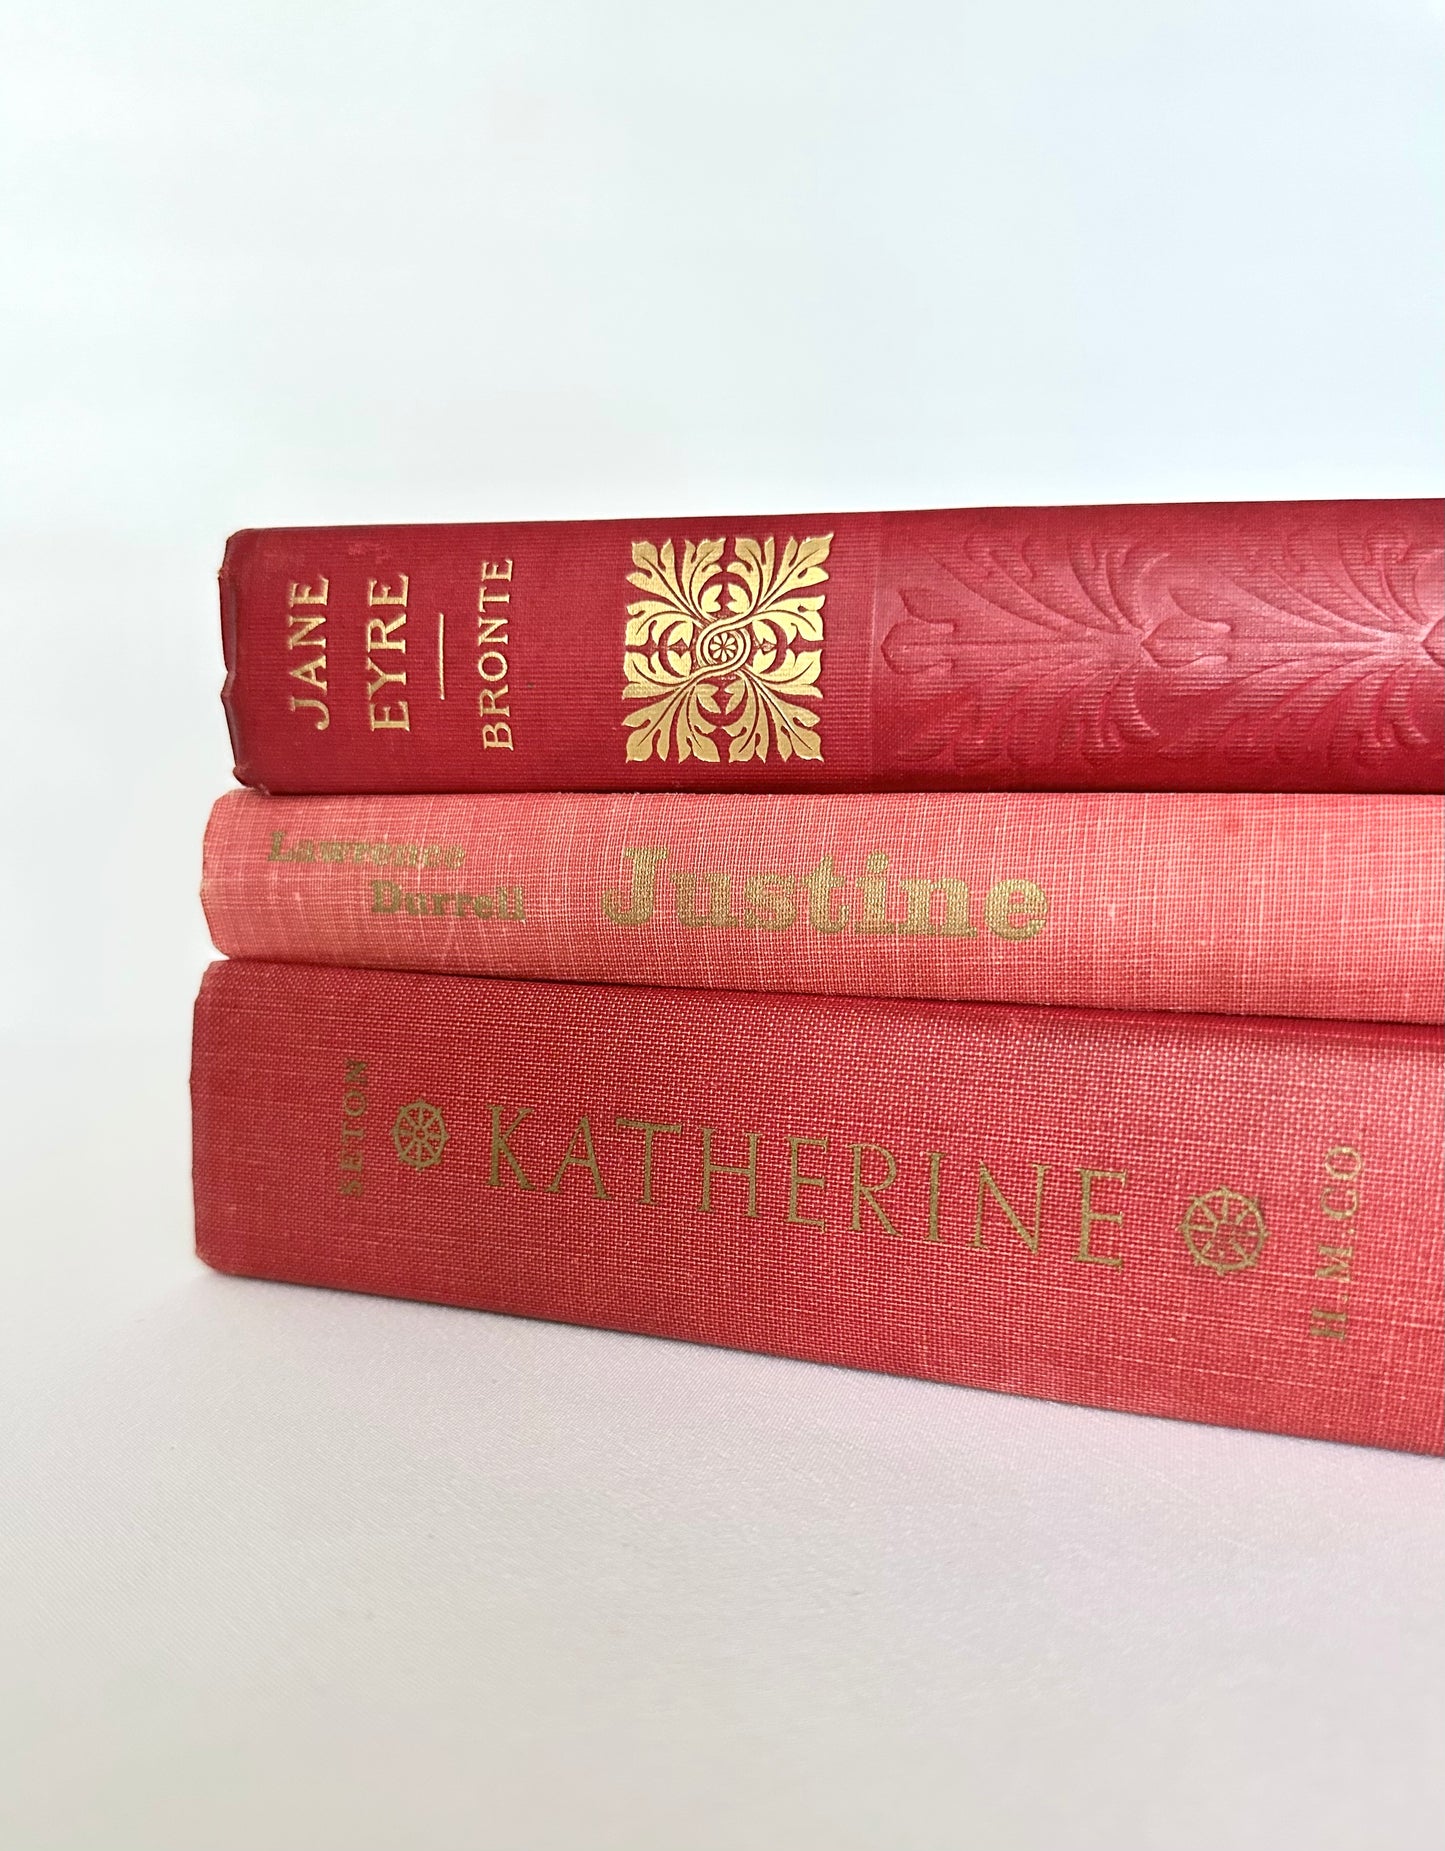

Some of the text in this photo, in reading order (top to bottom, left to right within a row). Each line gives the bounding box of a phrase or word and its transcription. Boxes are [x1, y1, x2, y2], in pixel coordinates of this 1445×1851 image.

[287, 575, 331, 732] JANE
[364, 572, 412, 732] EYRE
[477, 556, 515, 752] BRONTE
[267, 829, 467, 870] Lawrence
[371, 878, 526, 921] Durrell
[601, 846, 1050, 943] Justine
[339, 1057, 370, 1197] SETON
[485, 1103, 1129, 1272] KATHERINE
